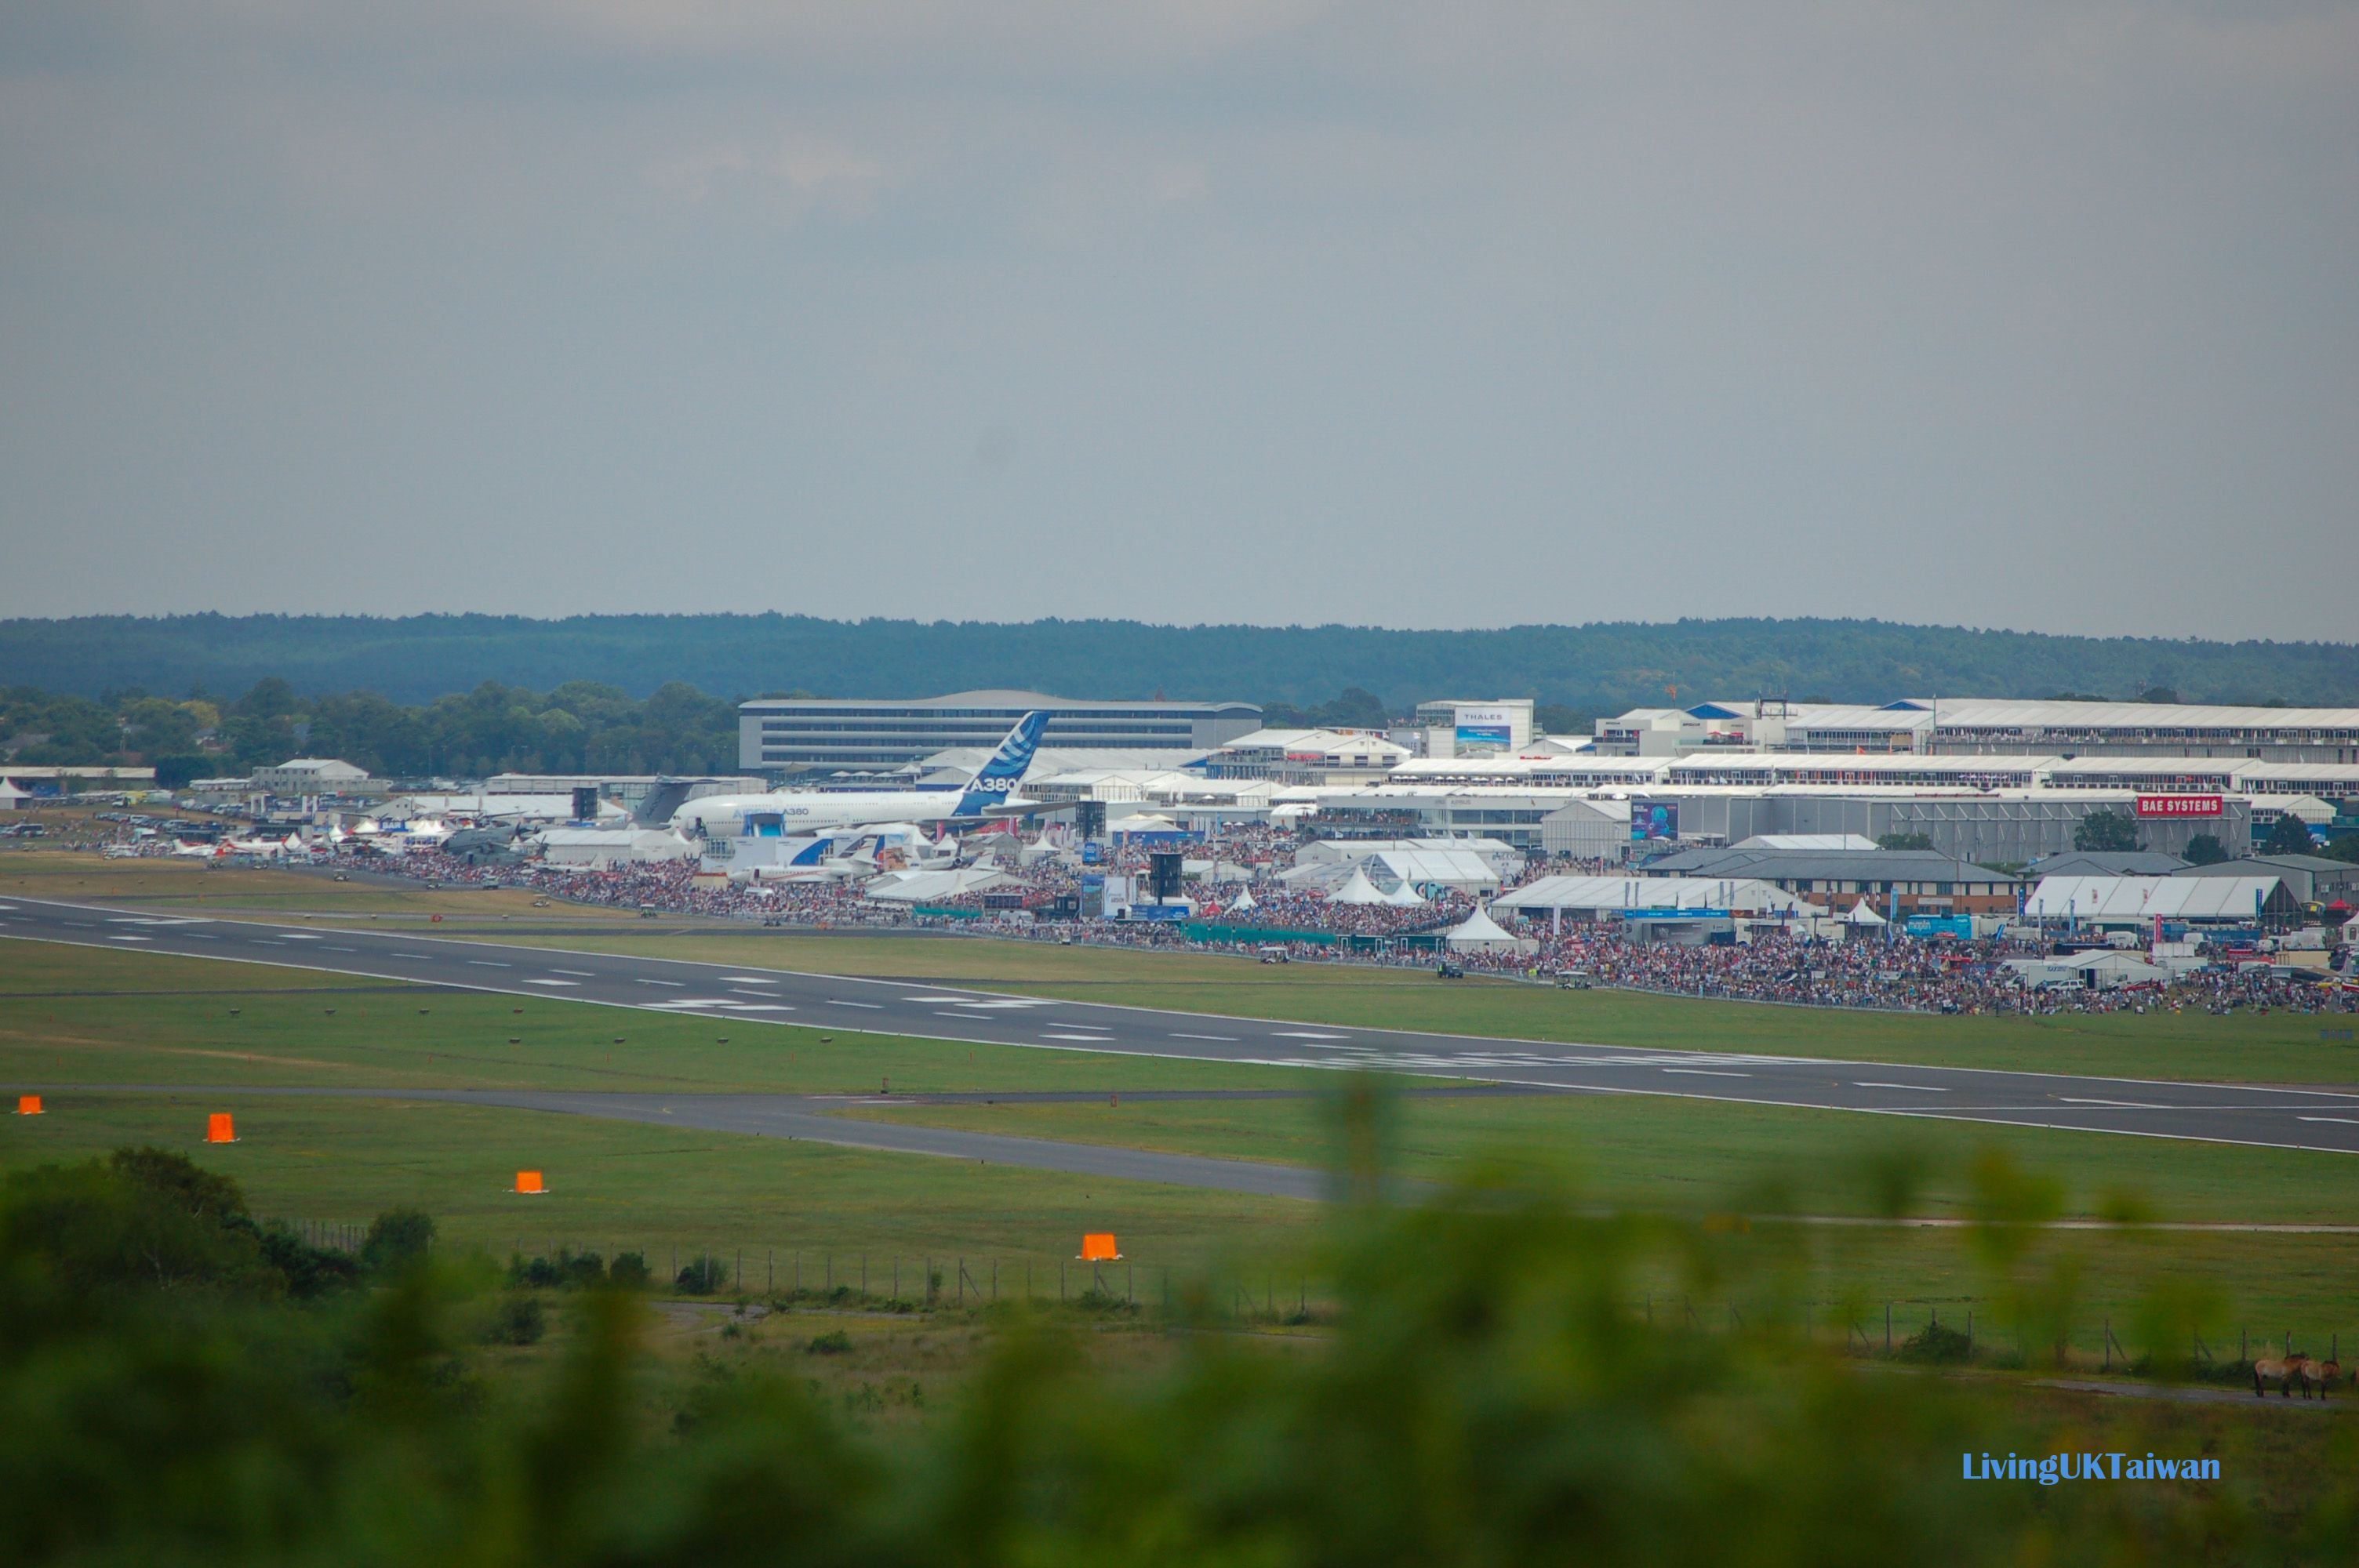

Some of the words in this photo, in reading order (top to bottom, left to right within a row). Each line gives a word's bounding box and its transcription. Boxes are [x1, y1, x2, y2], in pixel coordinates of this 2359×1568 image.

[970, 778, 1017, 793] A380
[783, 808, 809, 816] A380
[2142, 800, 2164, 812] BAE
[2167, 800, 2218, 812] SYSTEMS
